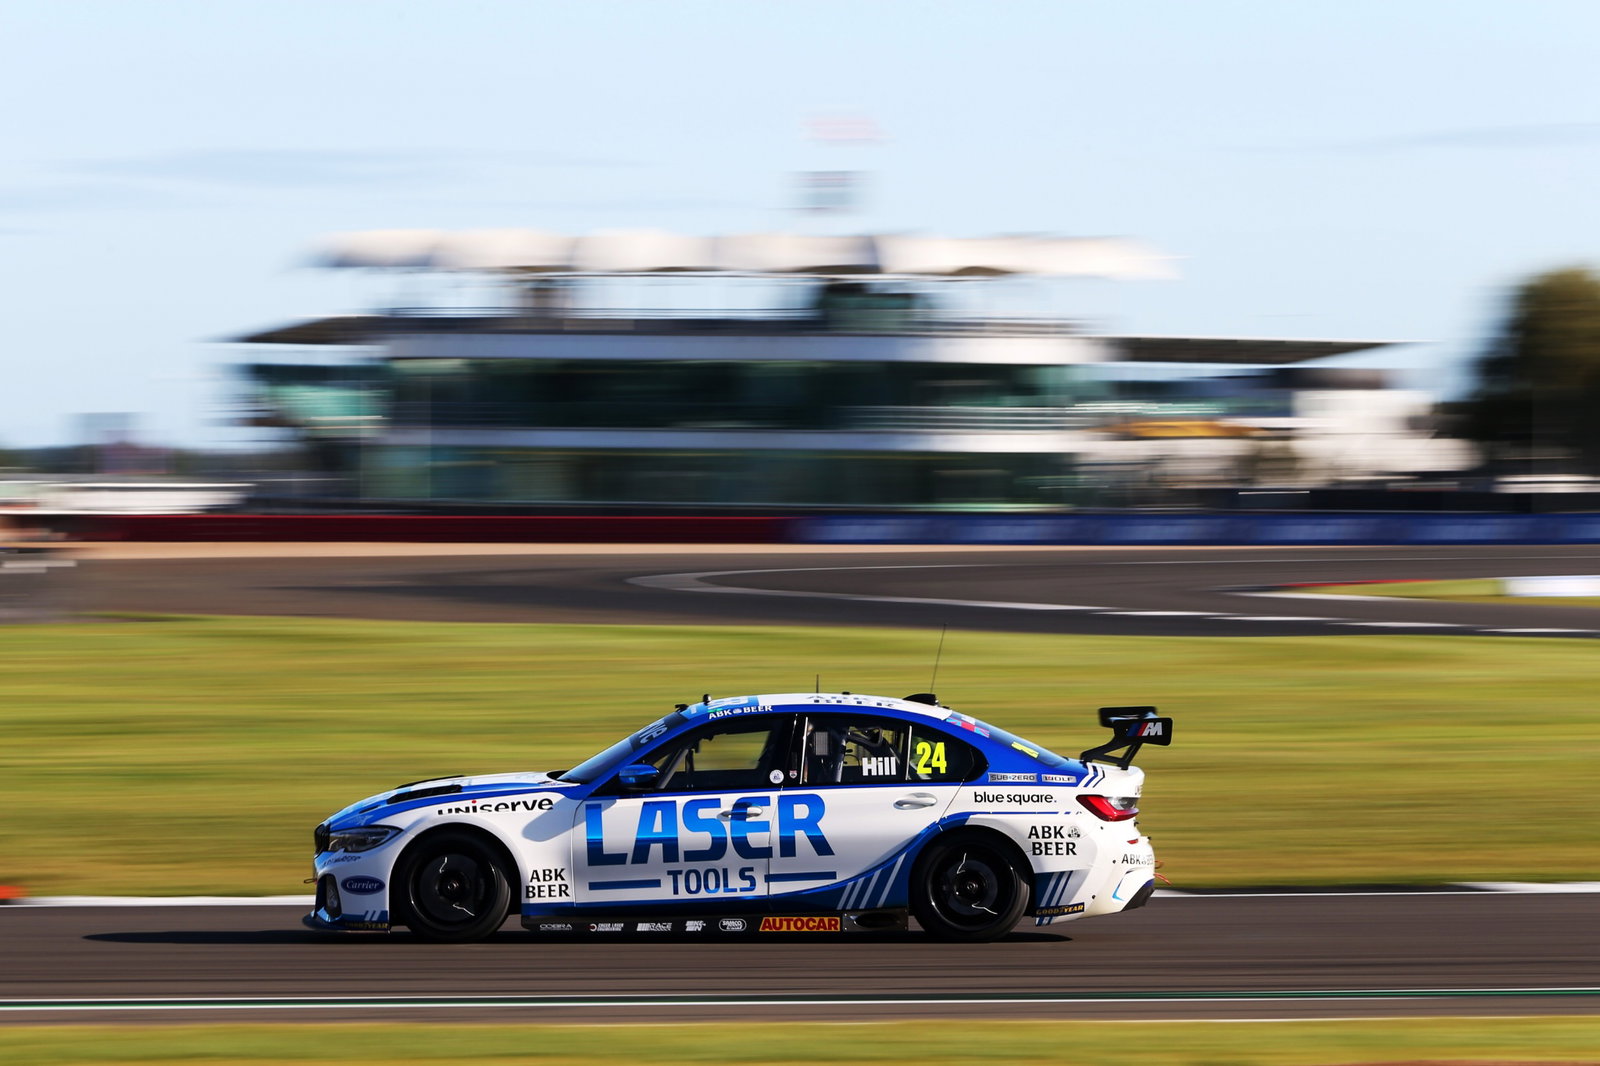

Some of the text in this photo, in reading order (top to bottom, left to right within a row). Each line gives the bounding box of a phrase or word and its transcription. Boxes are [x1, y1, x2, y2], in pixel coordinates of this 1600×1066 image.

[708, 705, 773, 720] ABK BEER
[916, 741, 947, 774] 24
[862, 756, 897, 776] Hill
[974, 791, 1004, 803] blue
[585, 793, 835, 867] LASER
[1028, 825, 1065, 839] ABK
[1032, 841, 1077, 856] BEER
[529, 868, 566, 883] ABK
[667, 867, 757, 895] TOOLS
[346, 880, 380, 889] Carrier
[525, 883, 570, 899] BEER
[760, 917, 839, 931] AUTOCAR
